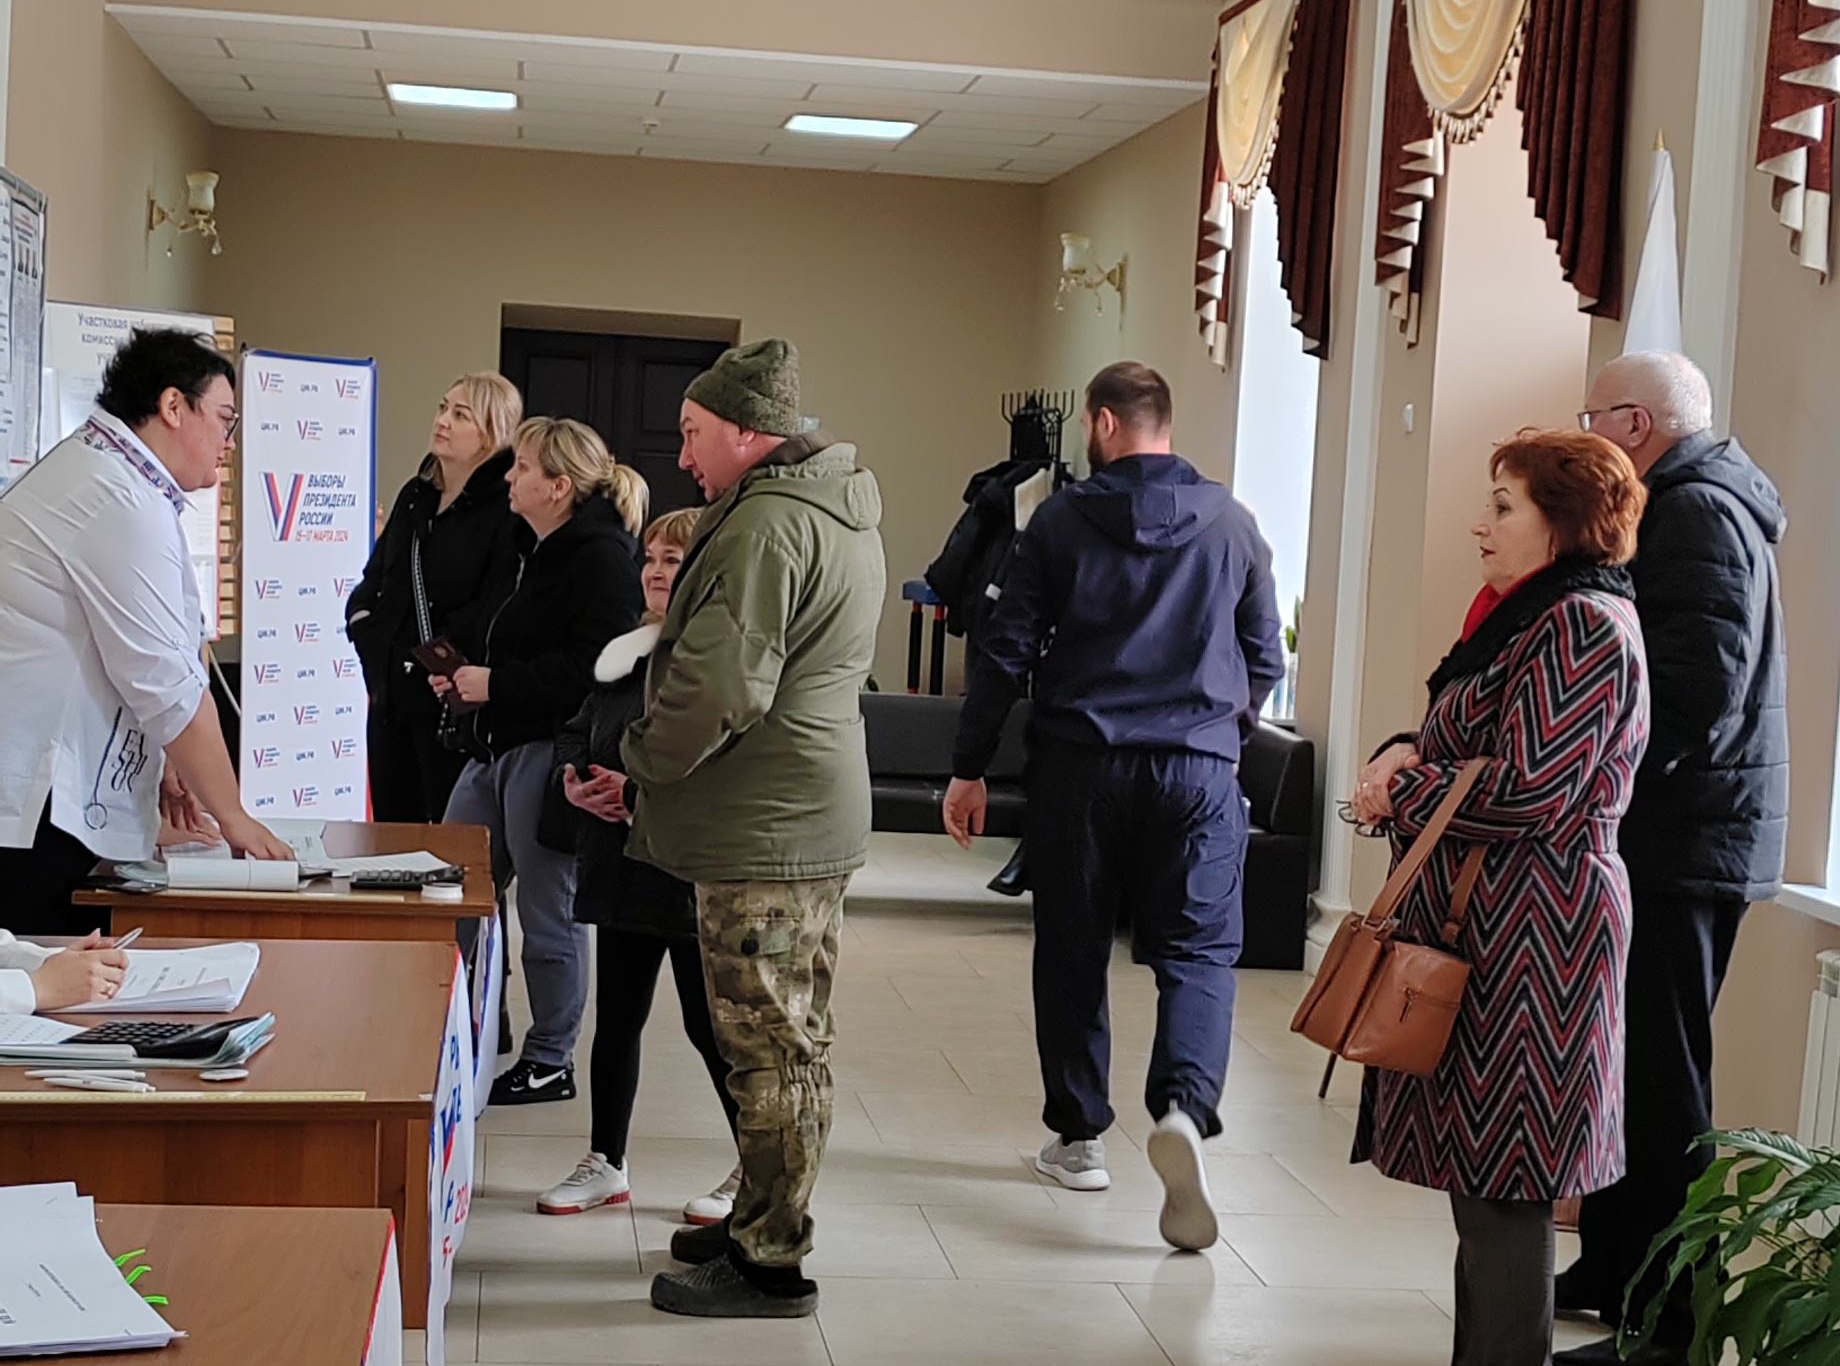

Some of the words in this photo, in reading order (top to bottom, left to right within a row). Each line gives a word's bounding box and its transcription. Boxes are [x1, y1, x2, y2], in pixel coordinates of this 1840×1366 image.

[78, 312, 128, 329] Участковая
[308, 474, 346, 488] ВЫБОРЫ
[303, 493, 356, 508] ПРЕЗИДЕНТА
[299, 512, 334, 525] РОССИИ
[313, 530, 333, 542] МАРТА
[334, 530, 349, 542] 2024
